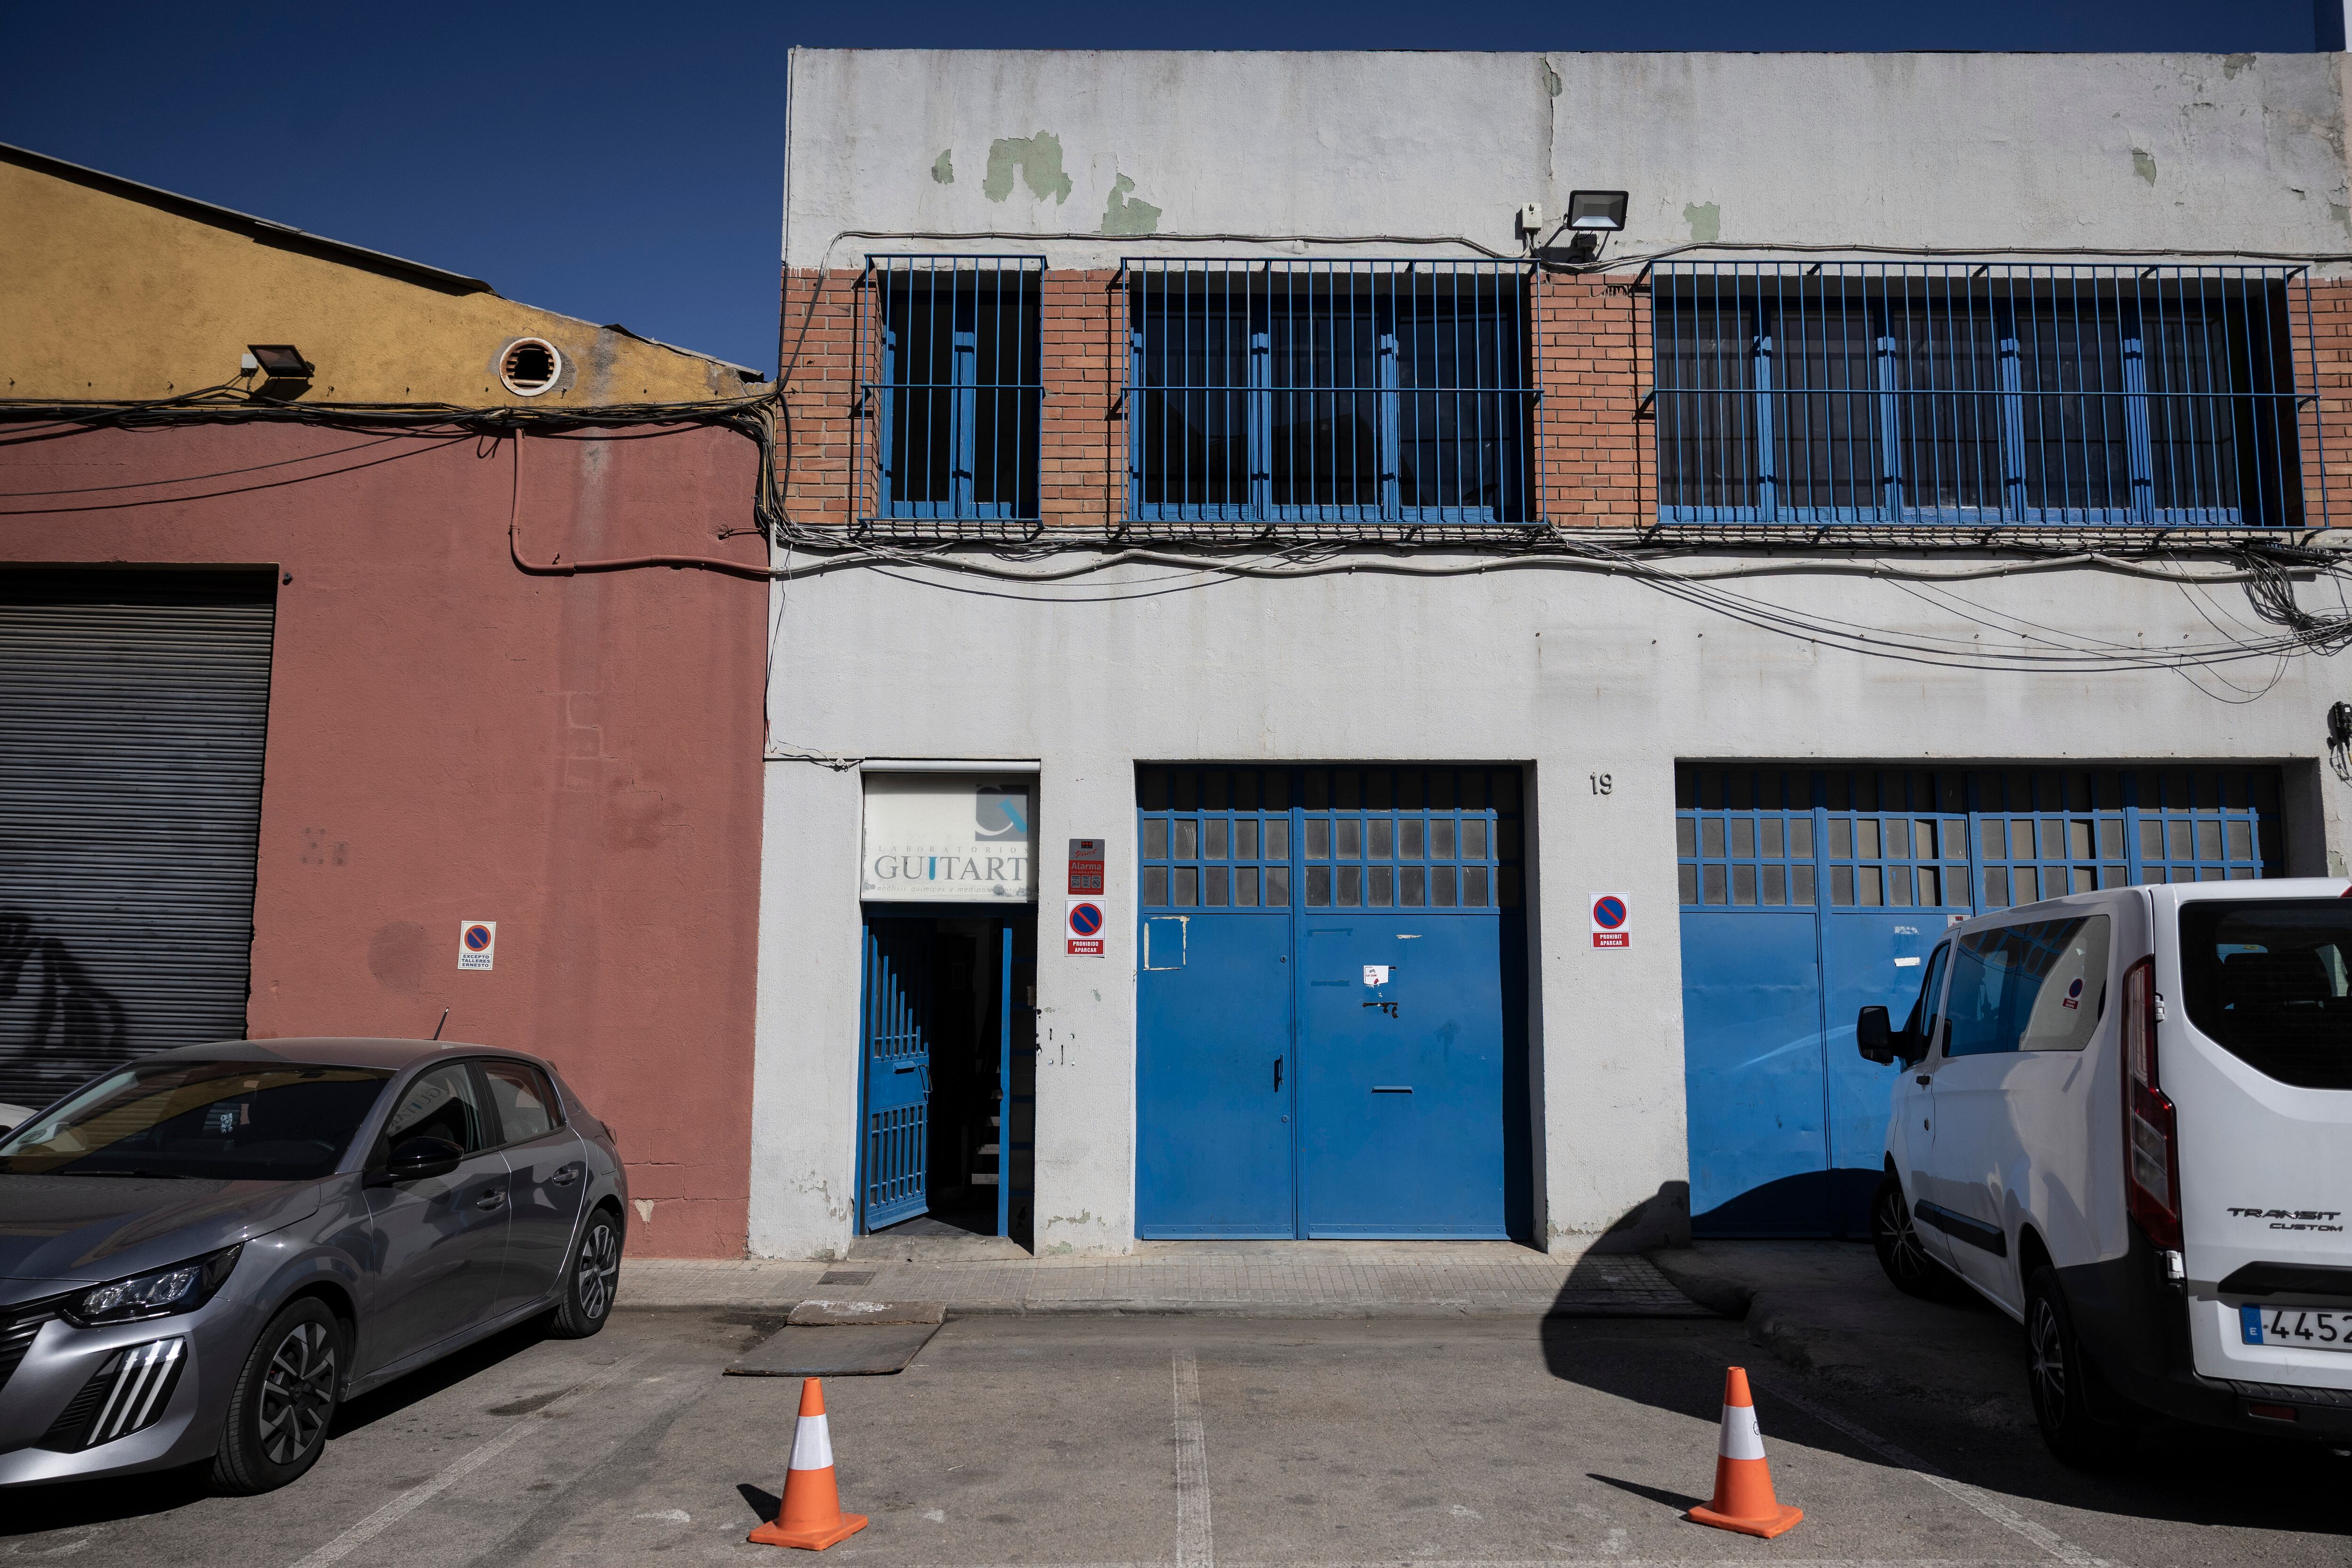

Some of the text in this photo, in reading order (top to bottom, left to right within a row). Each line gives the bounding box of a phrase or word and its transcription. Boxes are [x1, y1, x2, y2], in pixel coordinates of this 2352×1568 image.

[1590, 772, 1613, 795] 19
[879, 845, 1029, 853] LABORATORIOS
[874, 855, 1028, 881] GUITART
[2226, 1207, 2342, 1221] TRANSIT
[2269, 1223, 2344, 1232] CUSTOM
[2249, 1327, 2257, 1336] E
